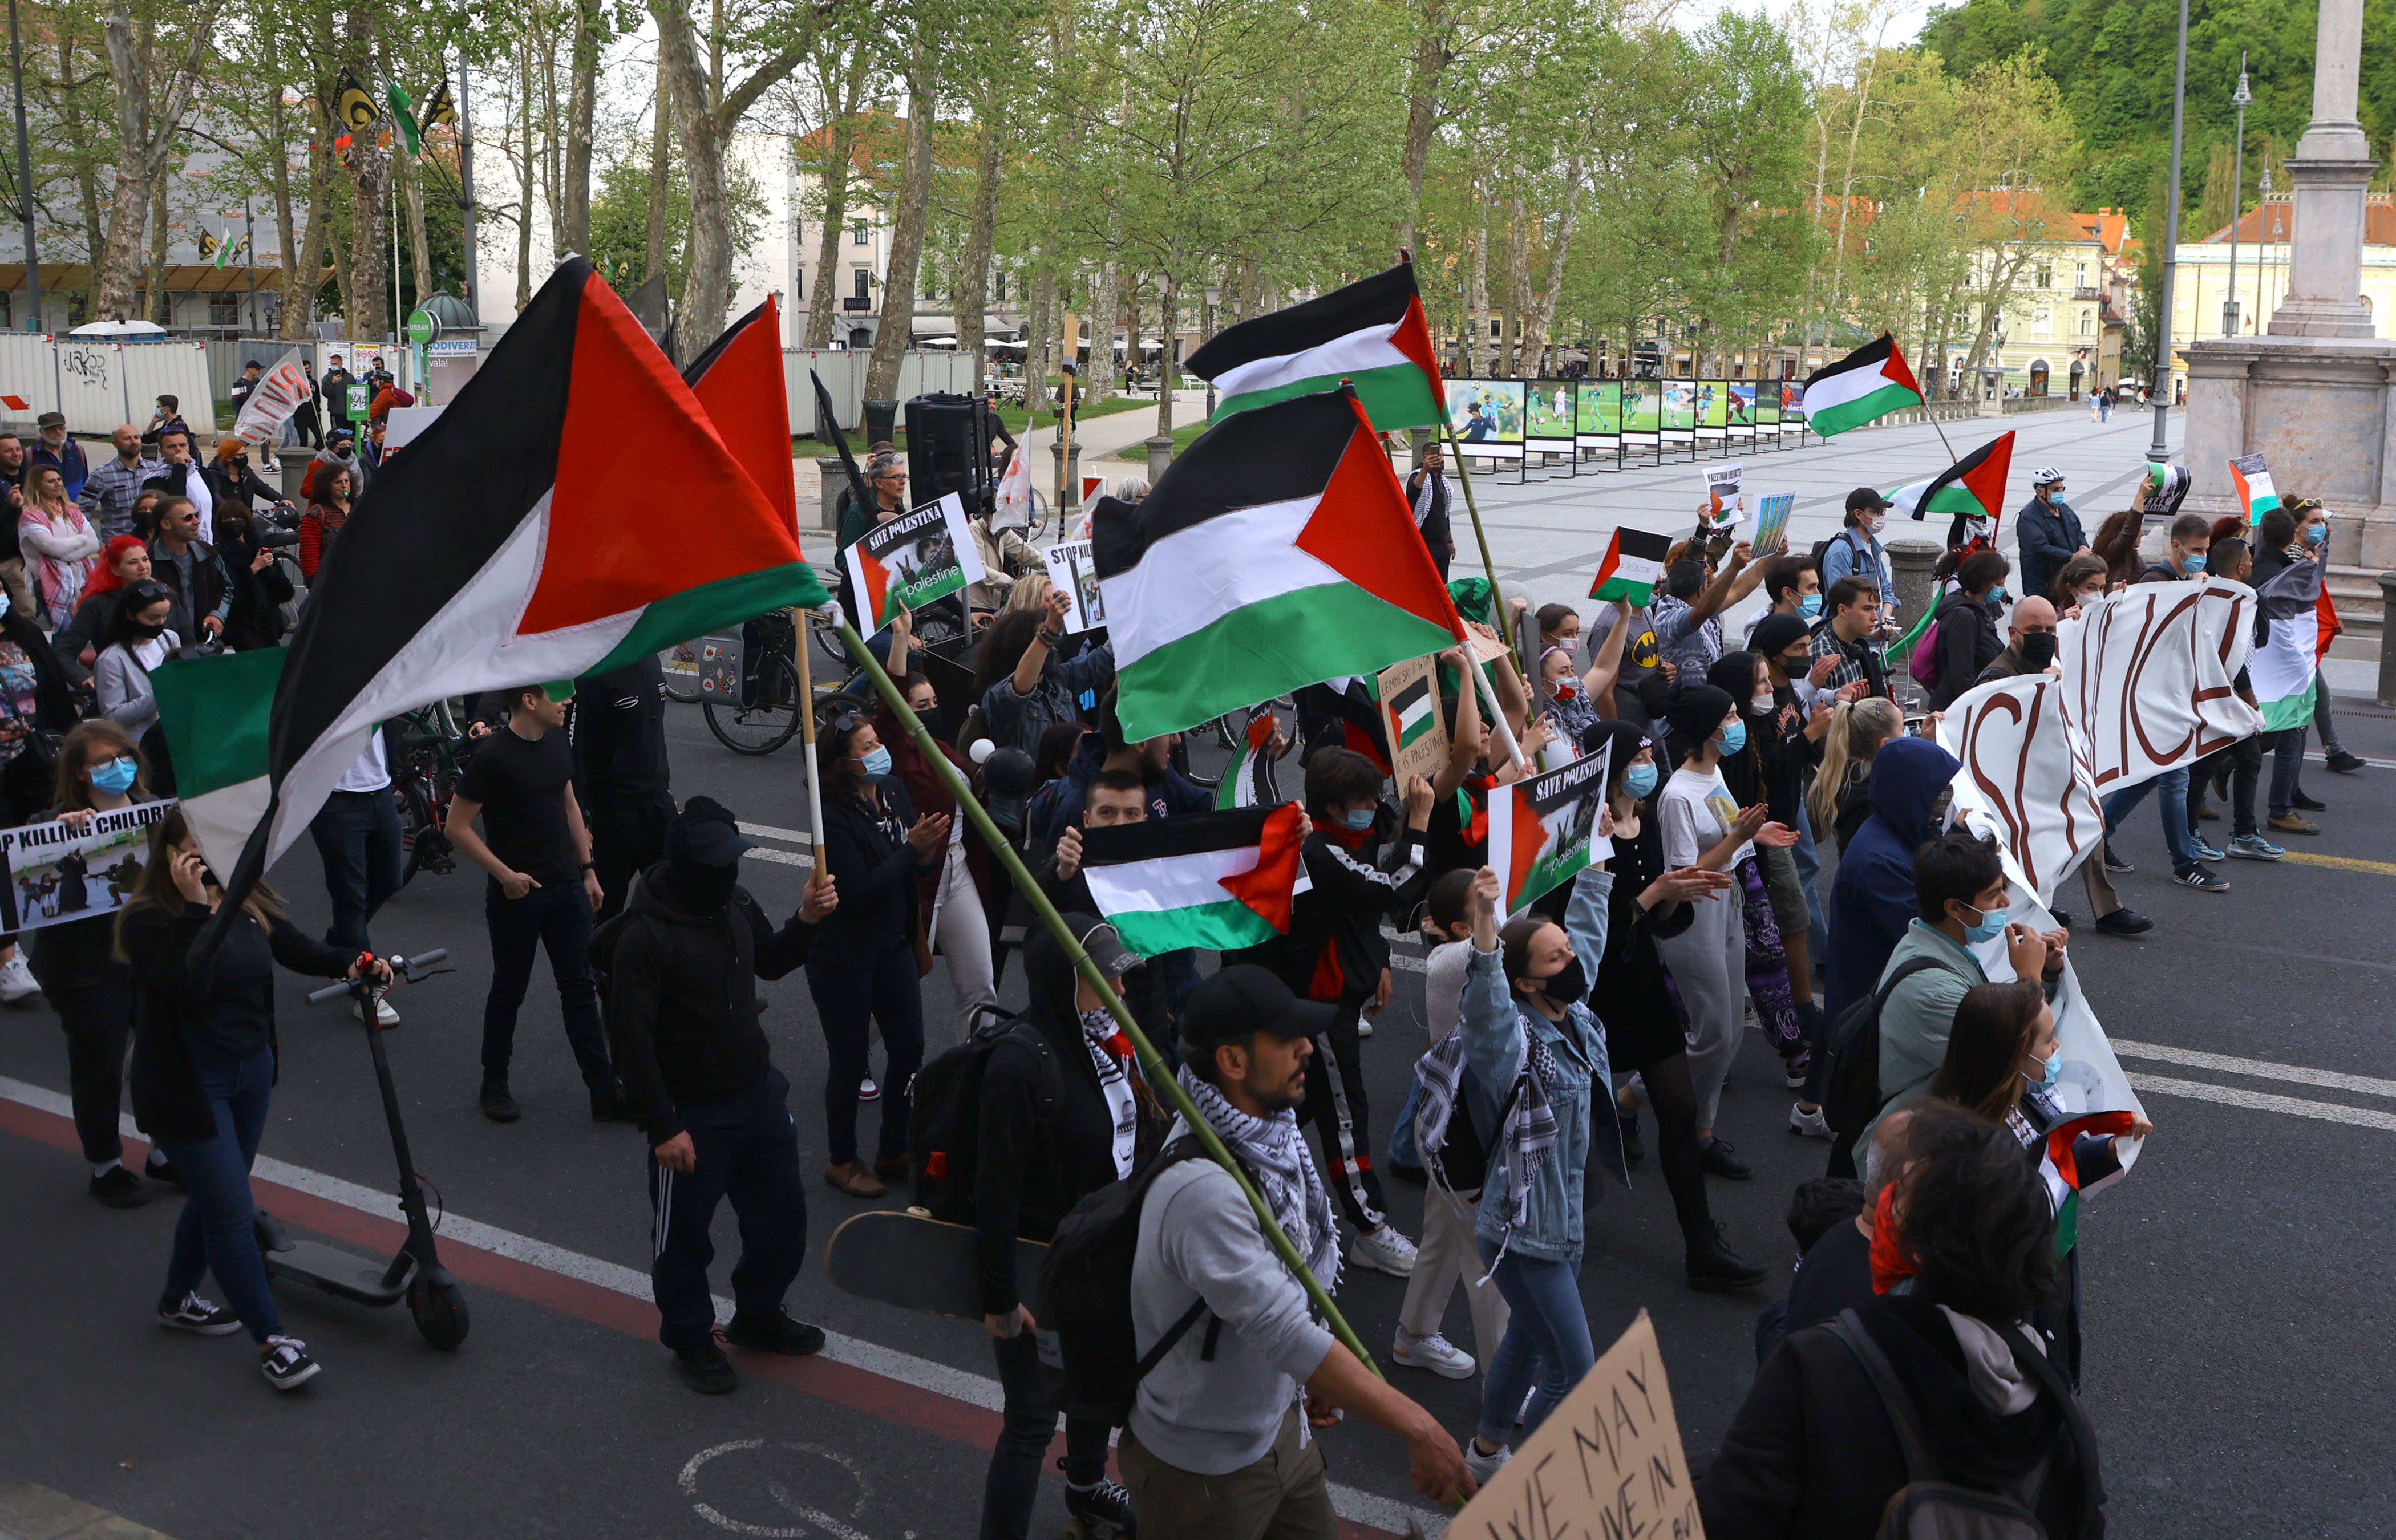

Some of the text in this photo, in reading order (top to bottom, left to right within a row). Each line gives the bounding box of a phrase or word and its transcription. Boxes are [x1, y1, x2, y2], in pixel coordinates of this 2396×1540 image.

[429, 358, 448, 367] vala!
[869, 505, 942, 551] SAVE PALESTINA
[1051, 546, 1077, 564] STOP
[895, 565, 959, 598] save palestine
[1381, 673, 1402, 696] LEMME
[1402, 666, 1412, 682] SAY
[1411, 662, 1416, 675] IT
[1395, 730, 1444, 775] IT IS PALESTINE
[1536, 773, 1561, 802] SAVE
[0, 834, 14, 851] P
[19, 822, 92, 849] KILLING
[1551, 836, 1589, 876] palestine
[1573, 1351, 1657, 1500] MAY
[1648, 1442, 1675, 1514] IN
